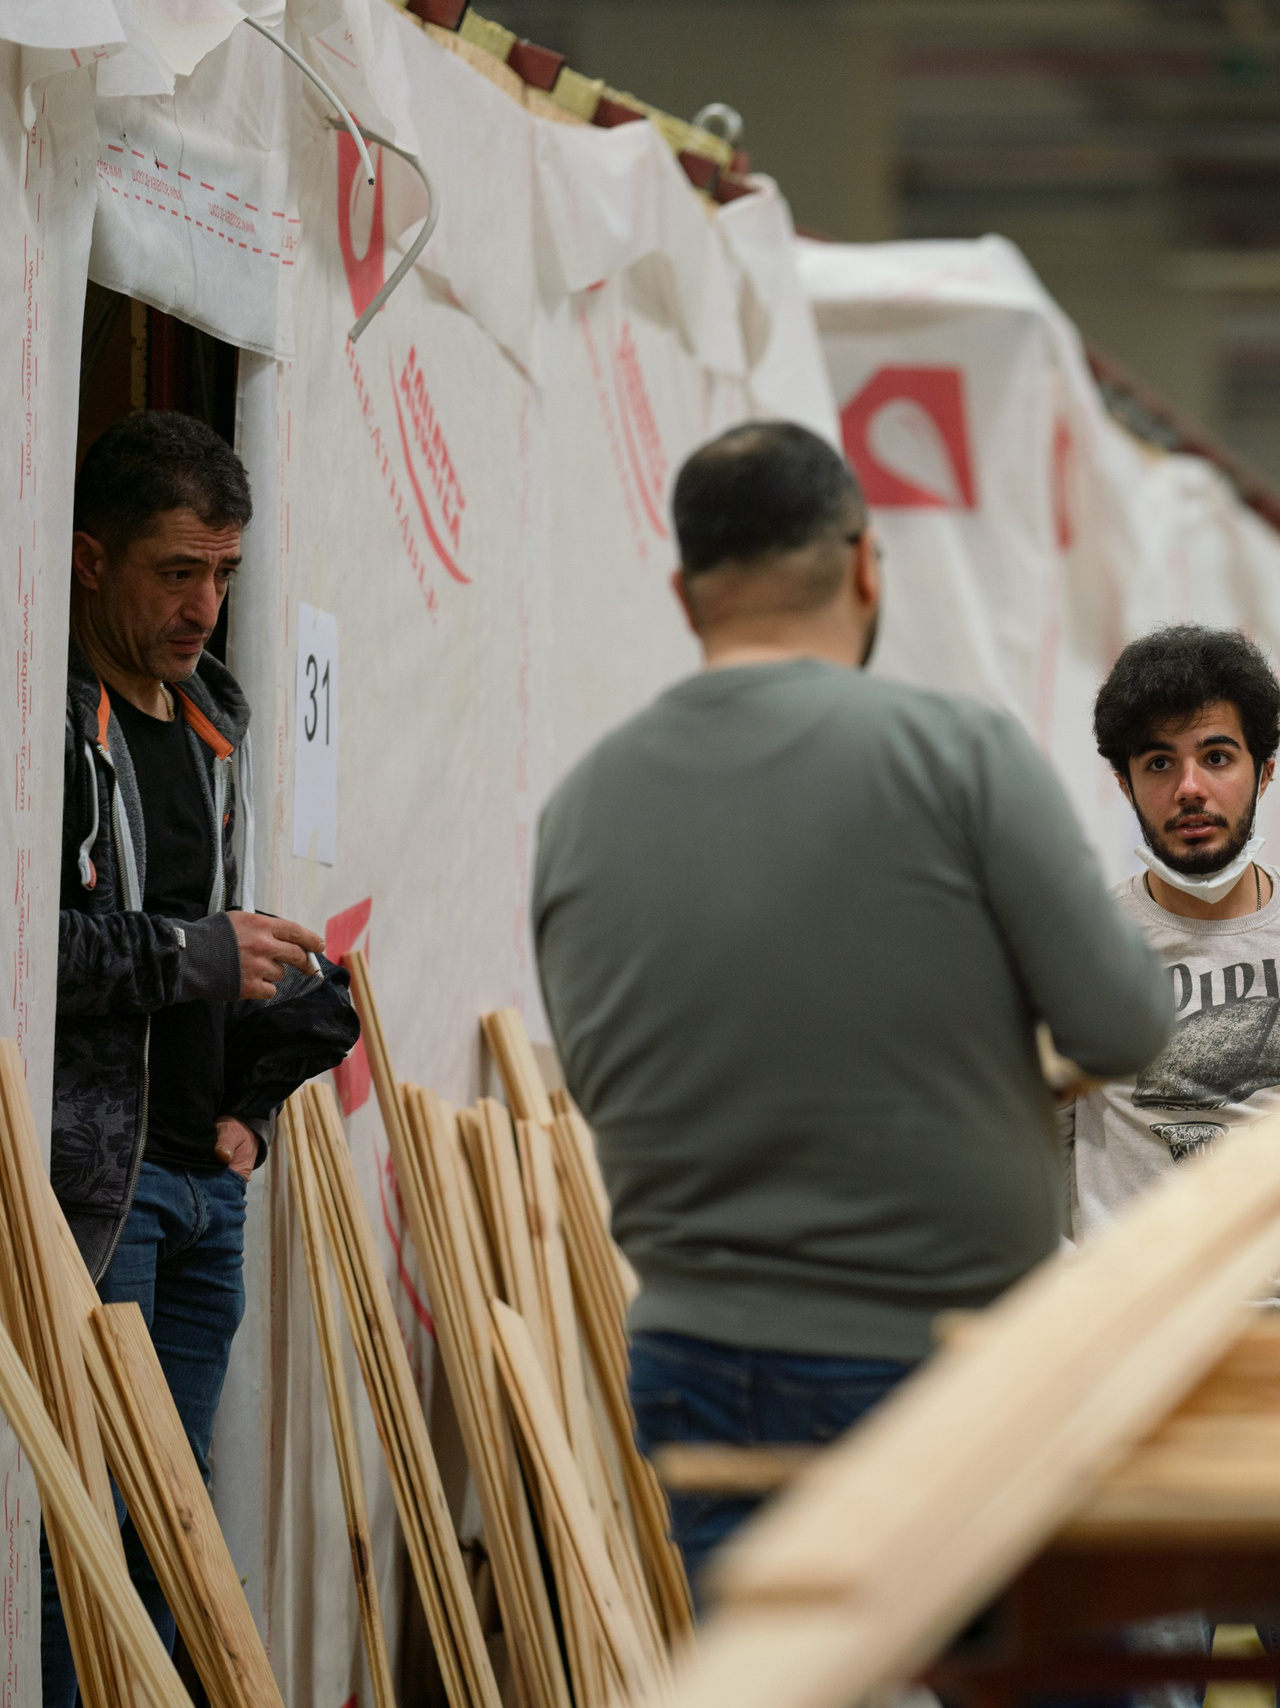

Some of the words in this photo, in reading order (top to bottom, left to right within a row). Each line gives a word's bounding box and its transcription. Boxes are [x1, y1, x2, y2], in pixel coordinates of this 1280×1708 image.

[26, 260, 34, 477] www.aquatex-tr.com
[20, 593, 29, 811] www.aquatex-tr.com
[304, 654, 331, 746] 31
